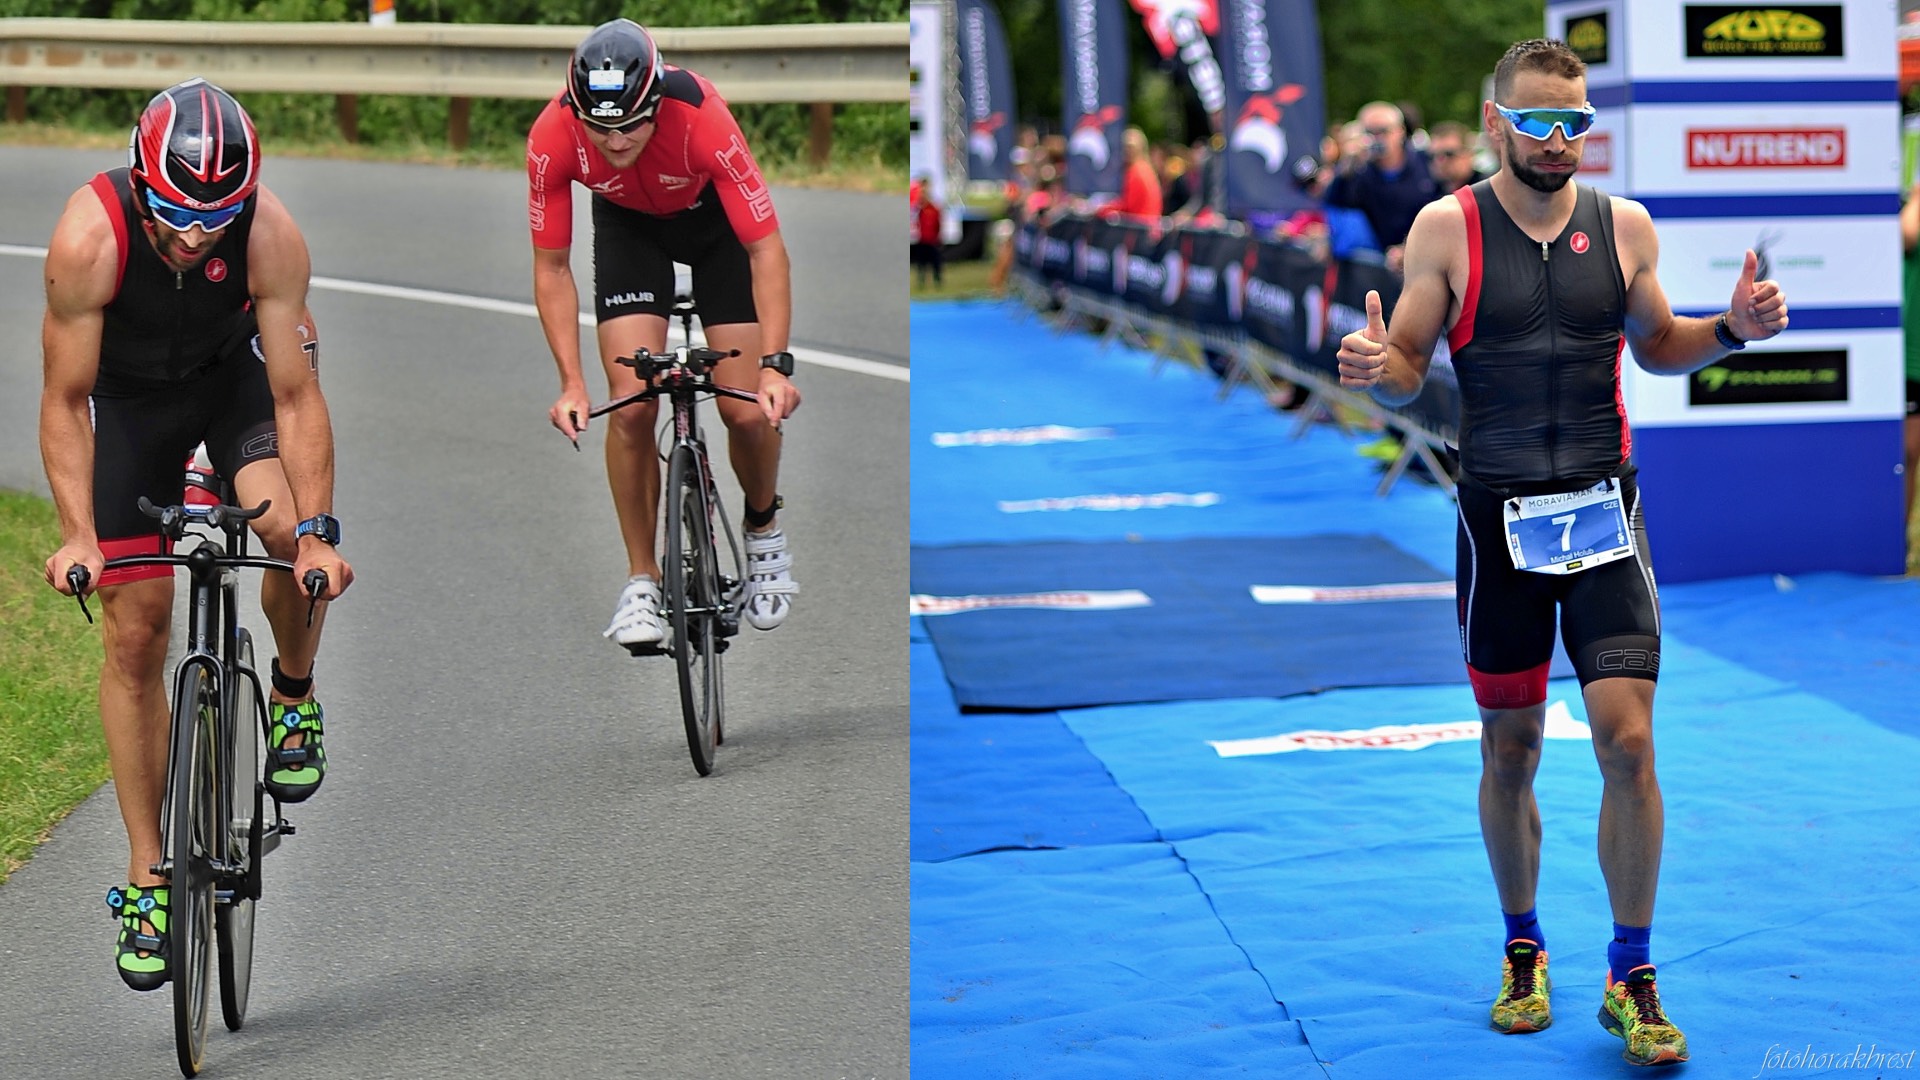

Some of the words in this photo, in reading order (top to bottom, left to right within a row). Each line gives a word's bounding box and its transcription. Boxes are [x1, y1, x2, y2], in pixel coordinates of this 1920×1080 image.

[591, 107, 623, 117] GIRO
[1692, 133, 1843, 166] NUTREND
[605, 291, 655, 307] HUUB
[300, 340, 317, 371] 7
[1528, 487, 1593, 508] MORAVIAMAN
[1603, 500, 1619, 510] CZE
[1551, 513, 1577, 552] 7
[1550, 552, 1573, 564] Michal
[1573, 548, 1594, 559] Holub
